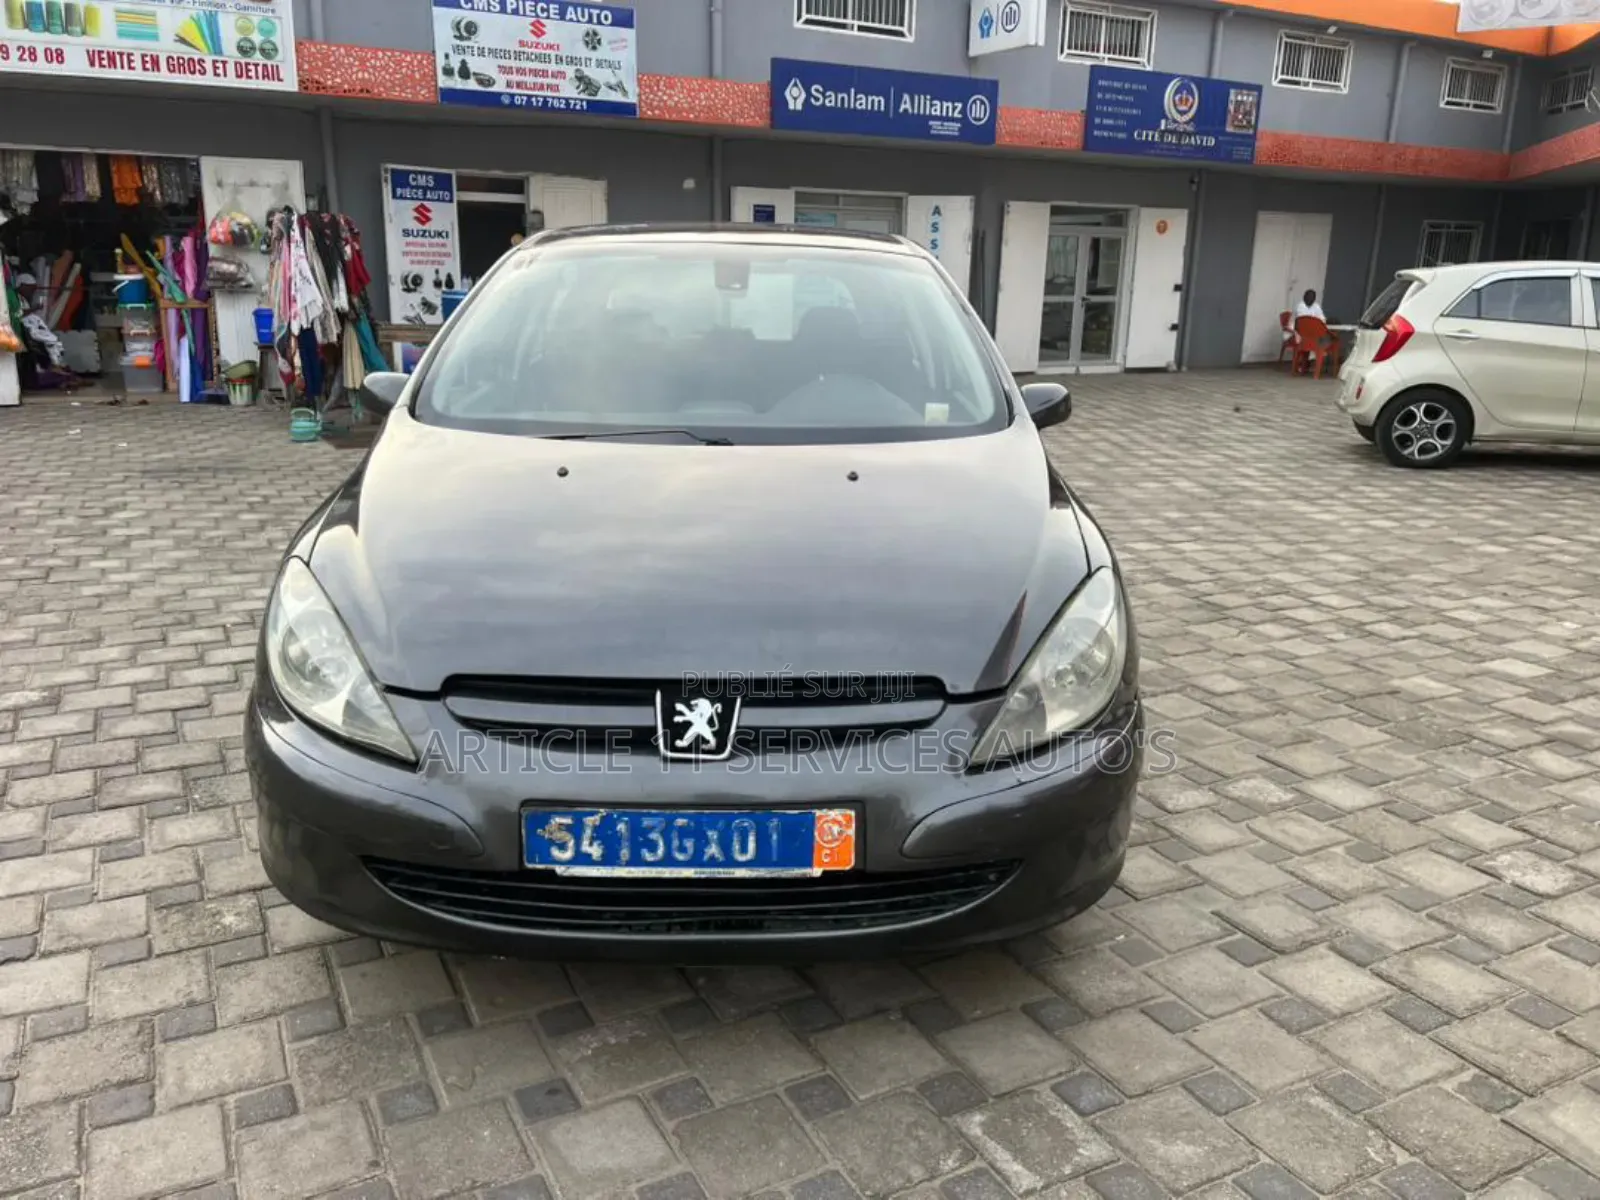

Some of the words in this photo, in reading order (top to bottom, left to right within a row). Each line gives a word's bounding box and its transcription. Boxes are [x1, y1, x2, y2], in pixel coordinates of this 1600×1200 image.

[460, 0, 500, 13] CMS
[565, 8, 613, 25] AUTO
[518, 39, 561, 51] SUZUKI
[16, 45, 38, 63] 28
[44, 46, 66, 65] 08
[86, 49, 136, 71] VENTE
[141, 53, 161, 73] EN
[166, 56, 207, 77] GROS
[212, 60, 229, 79] ET
[234, 61, 284, 82] DETAIL
[452, 44, 475, 56] VENTE
[477, 47, 486, 58] DE
[487, 48, 512, 60] PIECES
[555, 54, 564, 65] EN
[566, 55, 583, 67] GROS
[585, 57, 593, 68] ET
[595, 58, 622, 71] DETAILS
[498, 65, 514, 76] TOUS
[551, 69, 567, 80] AUTO
[506, 80, 514, 89] AU
[546, 82, 560, 93] PRIX
[513, 96, 524, 106] 07
[531, 96, 543, 107] 17
[569, 99, 588, 110] 721
[809, 83, 885, 113] Sanlam
[898, 92, 963, 119] Allianz
[1180, 134, 1216, 147] DAVID
[408, 173, 435, 188] CMS
[426, 190, 451, 201] AUTO
[401, 228, 450, 240] SUZUKI
